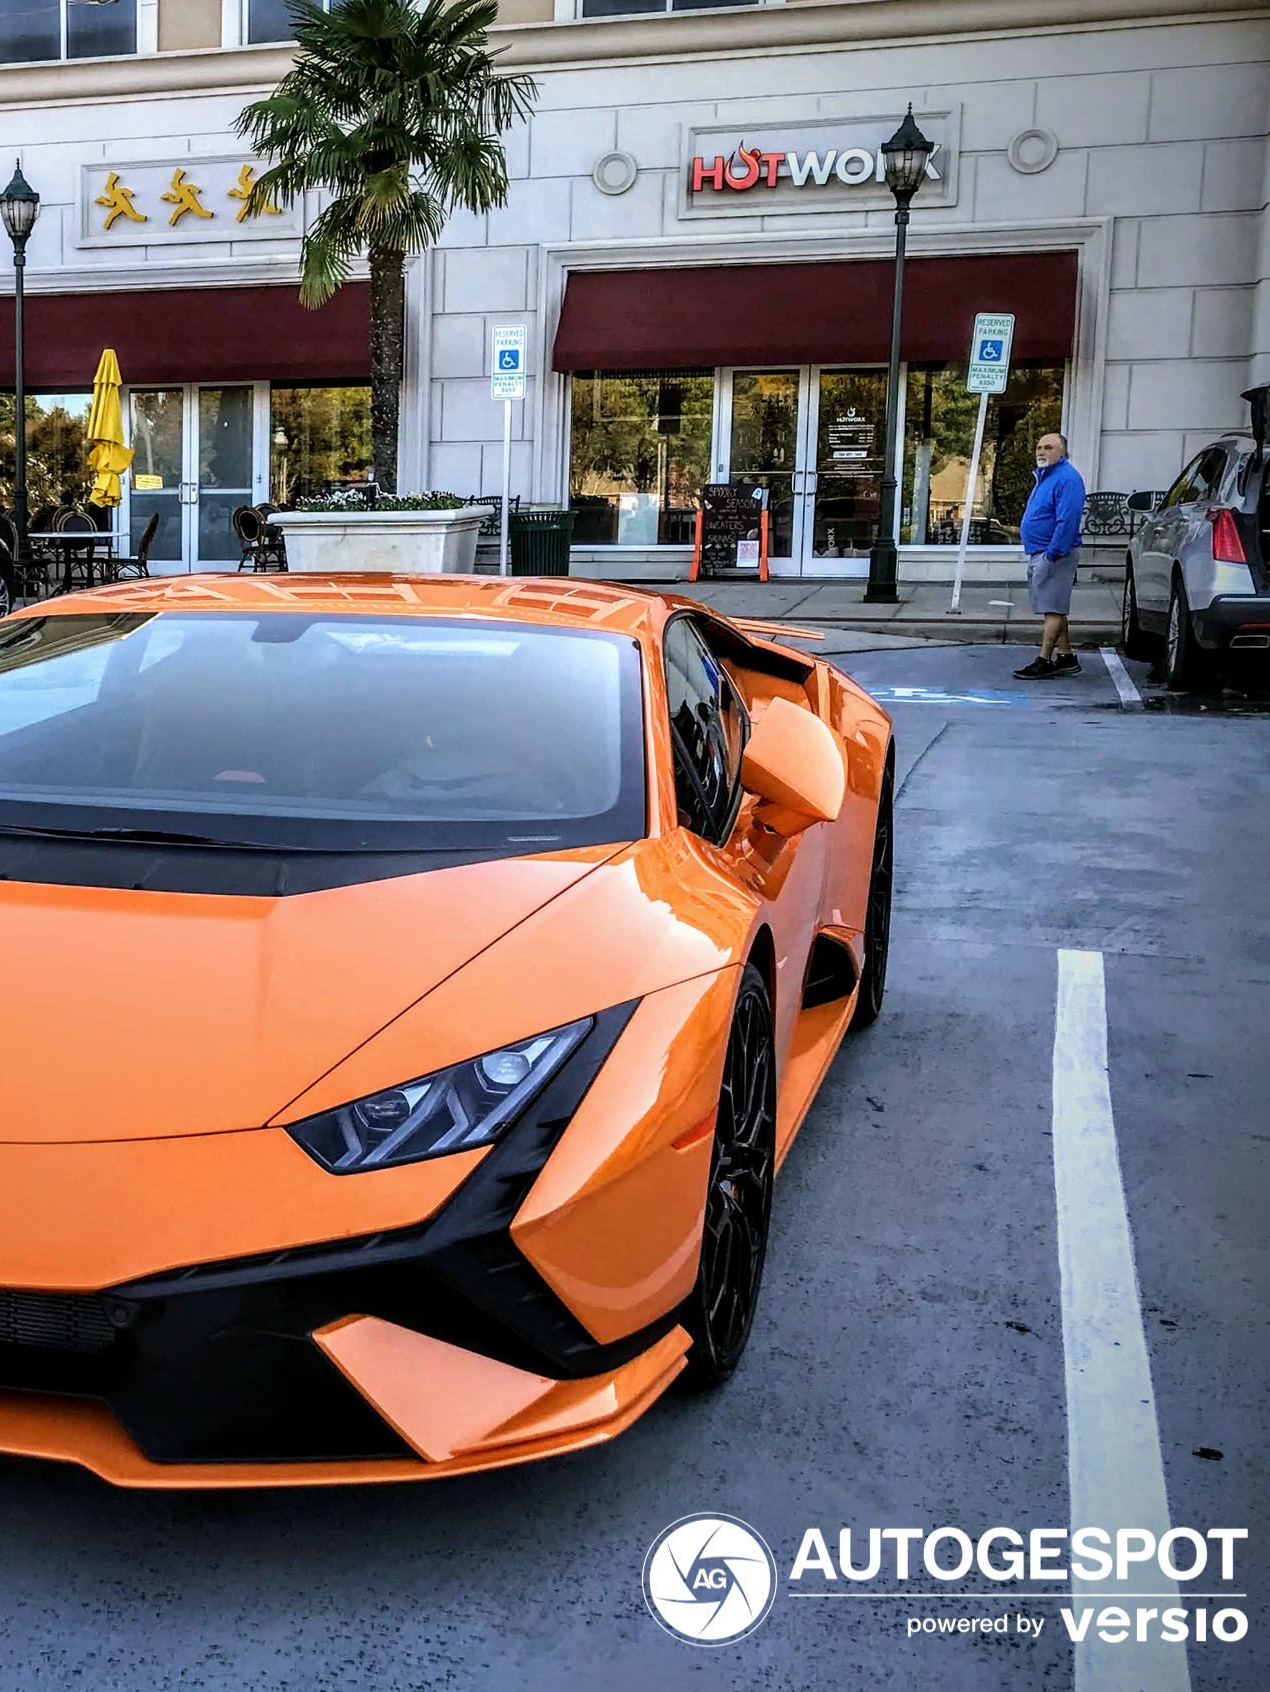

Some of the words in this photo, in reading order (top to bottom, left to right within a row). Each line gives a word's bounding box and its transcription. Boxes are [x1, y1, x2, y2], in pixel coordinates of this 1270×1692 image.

[978, 319, 1010, 327] RESERVED
[979, 328, 1008, 336] PARKING
[708, 487, 738, 498] SPOOKY
[726, 499, 757, 509] SEASON
